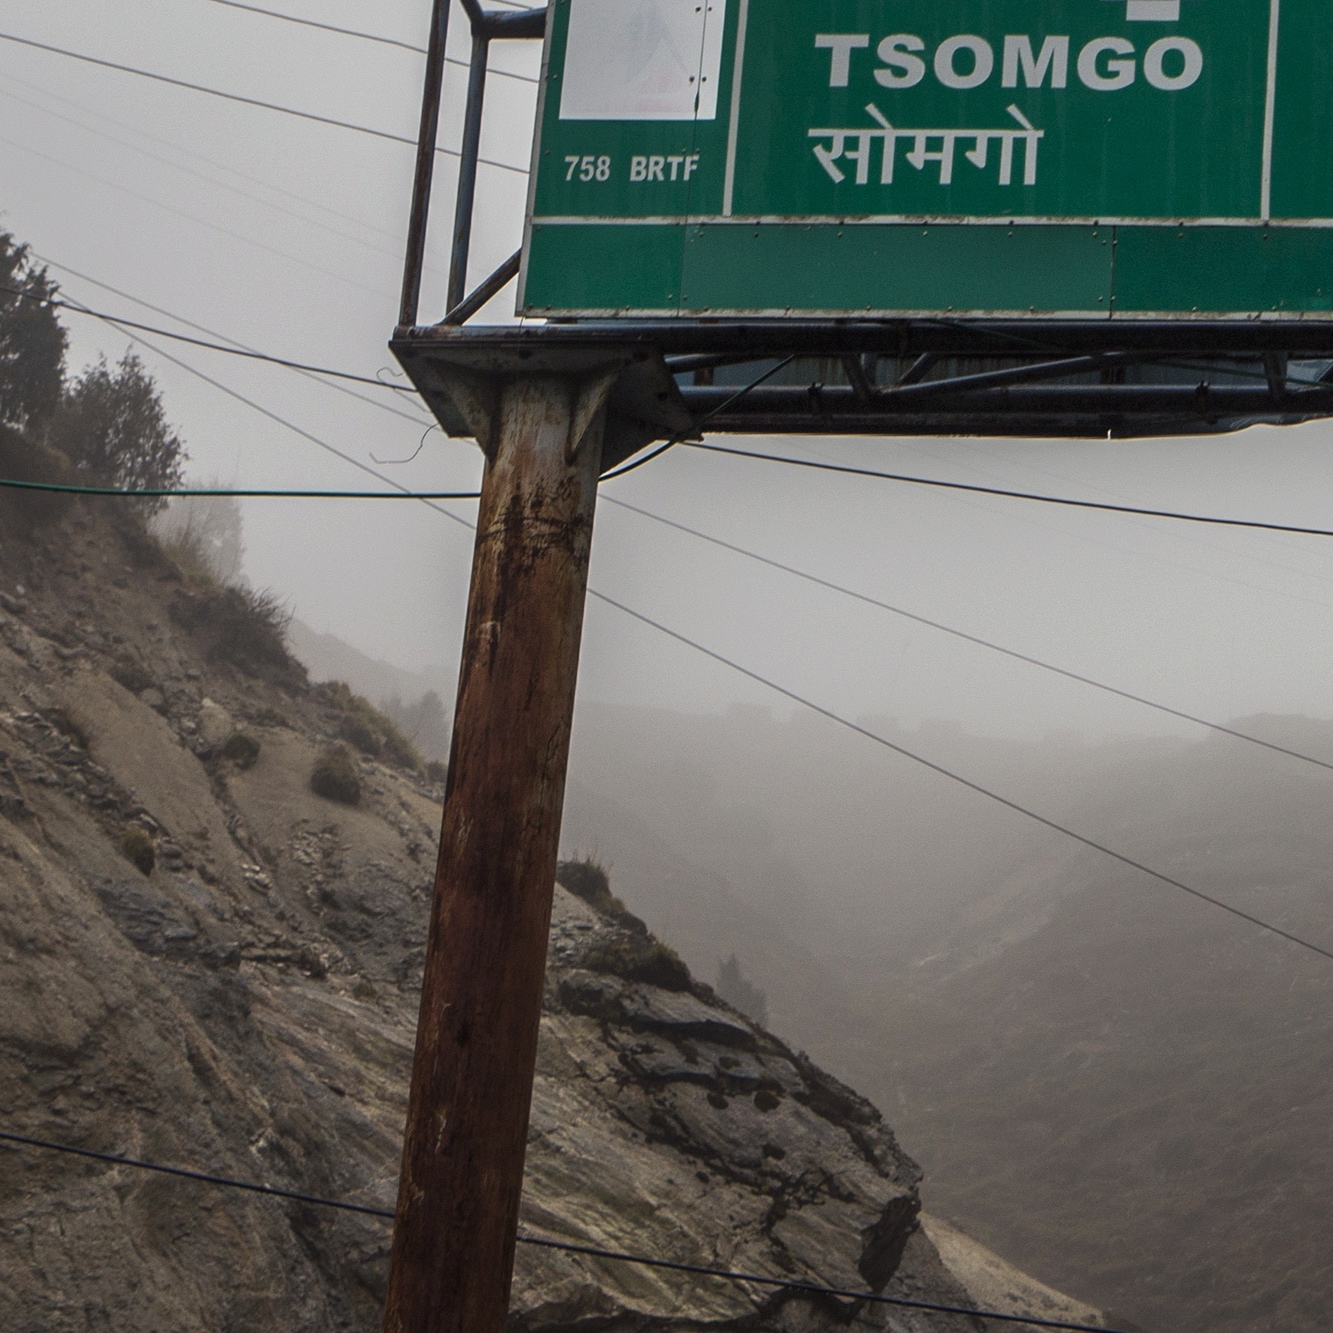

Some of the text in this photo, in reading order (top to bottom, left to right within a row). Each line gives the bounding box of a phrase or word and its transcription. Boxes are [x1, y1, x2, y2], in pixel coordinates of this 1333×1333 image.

[814, 33, 1203, 91] TSOMGO
[564, 154, 700, 182] 758 BRTF
[807, 102, 1045, 186] सोमगो
